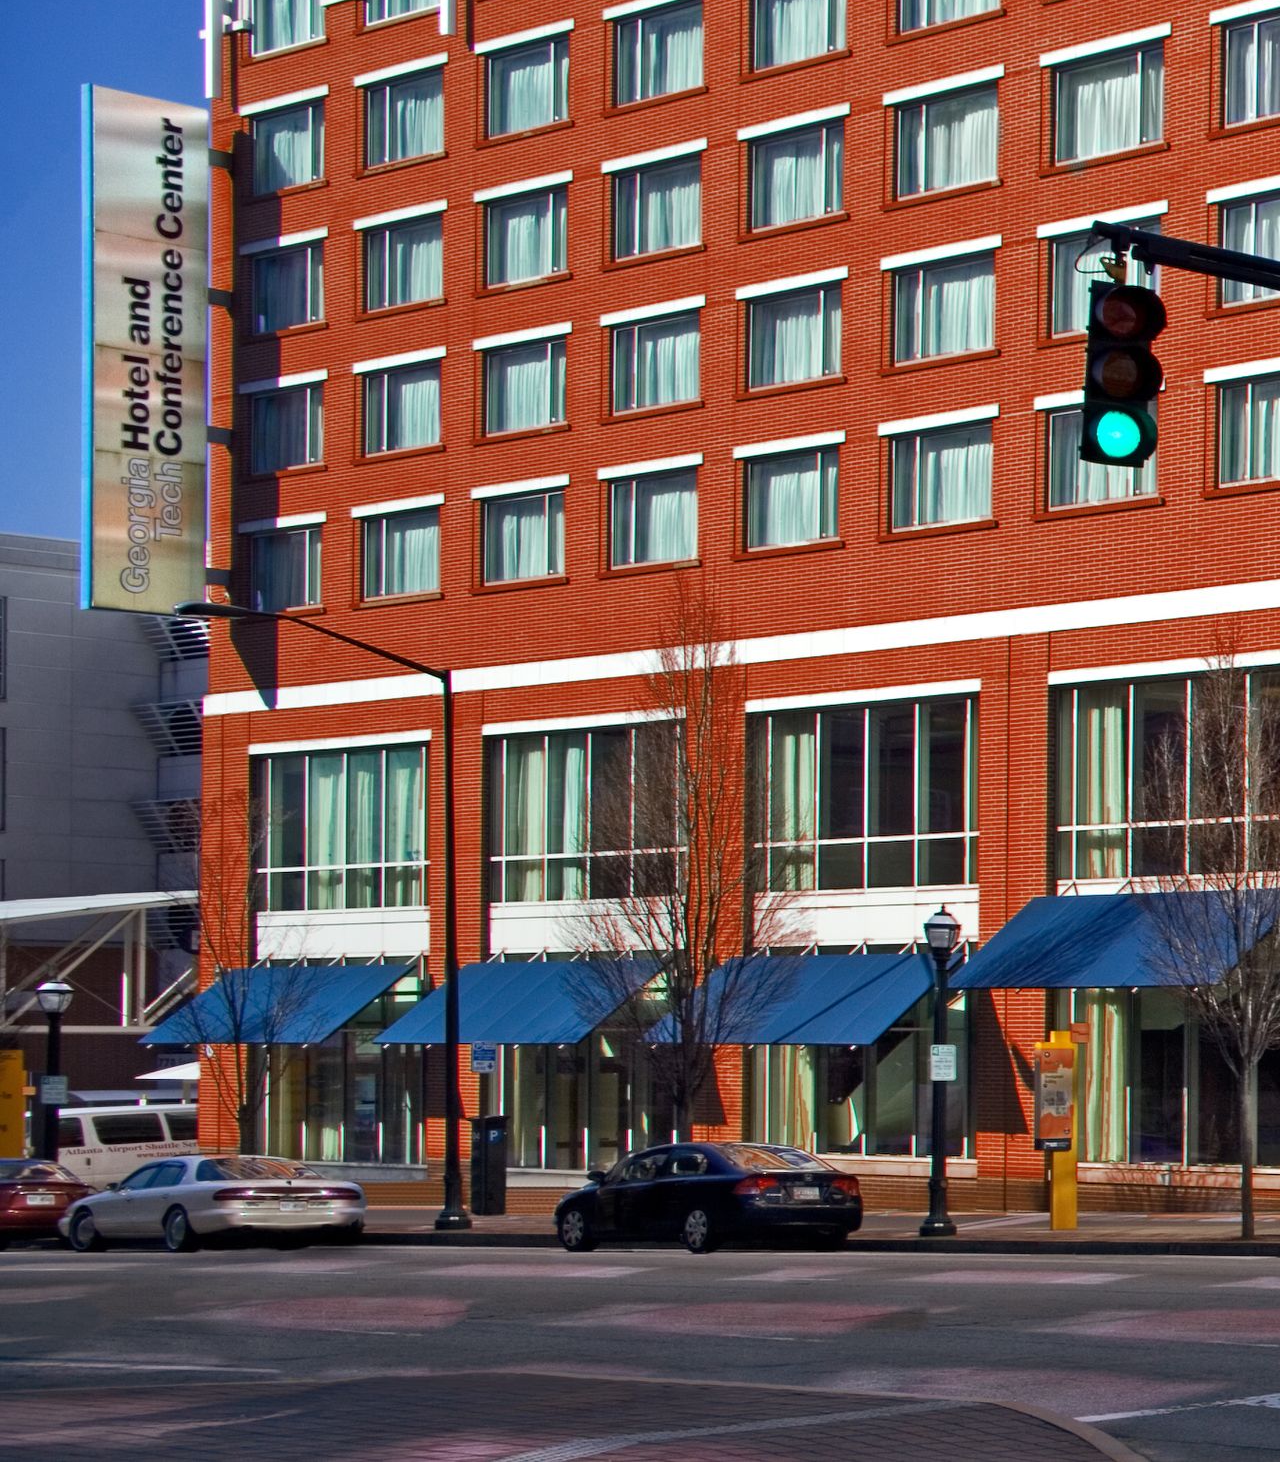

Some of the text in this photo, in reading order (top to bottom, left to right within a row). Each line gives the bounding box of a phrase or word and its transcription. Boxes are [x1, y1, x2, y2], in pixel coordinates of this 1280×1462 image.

[119, 275, 157, 594] Georgia Hotel and
[153, 117, 184, 542] Tech Conference Center
[65, 1148, 103, 1156] Atlanta
[107, 1146, 142, 1154] Airport
